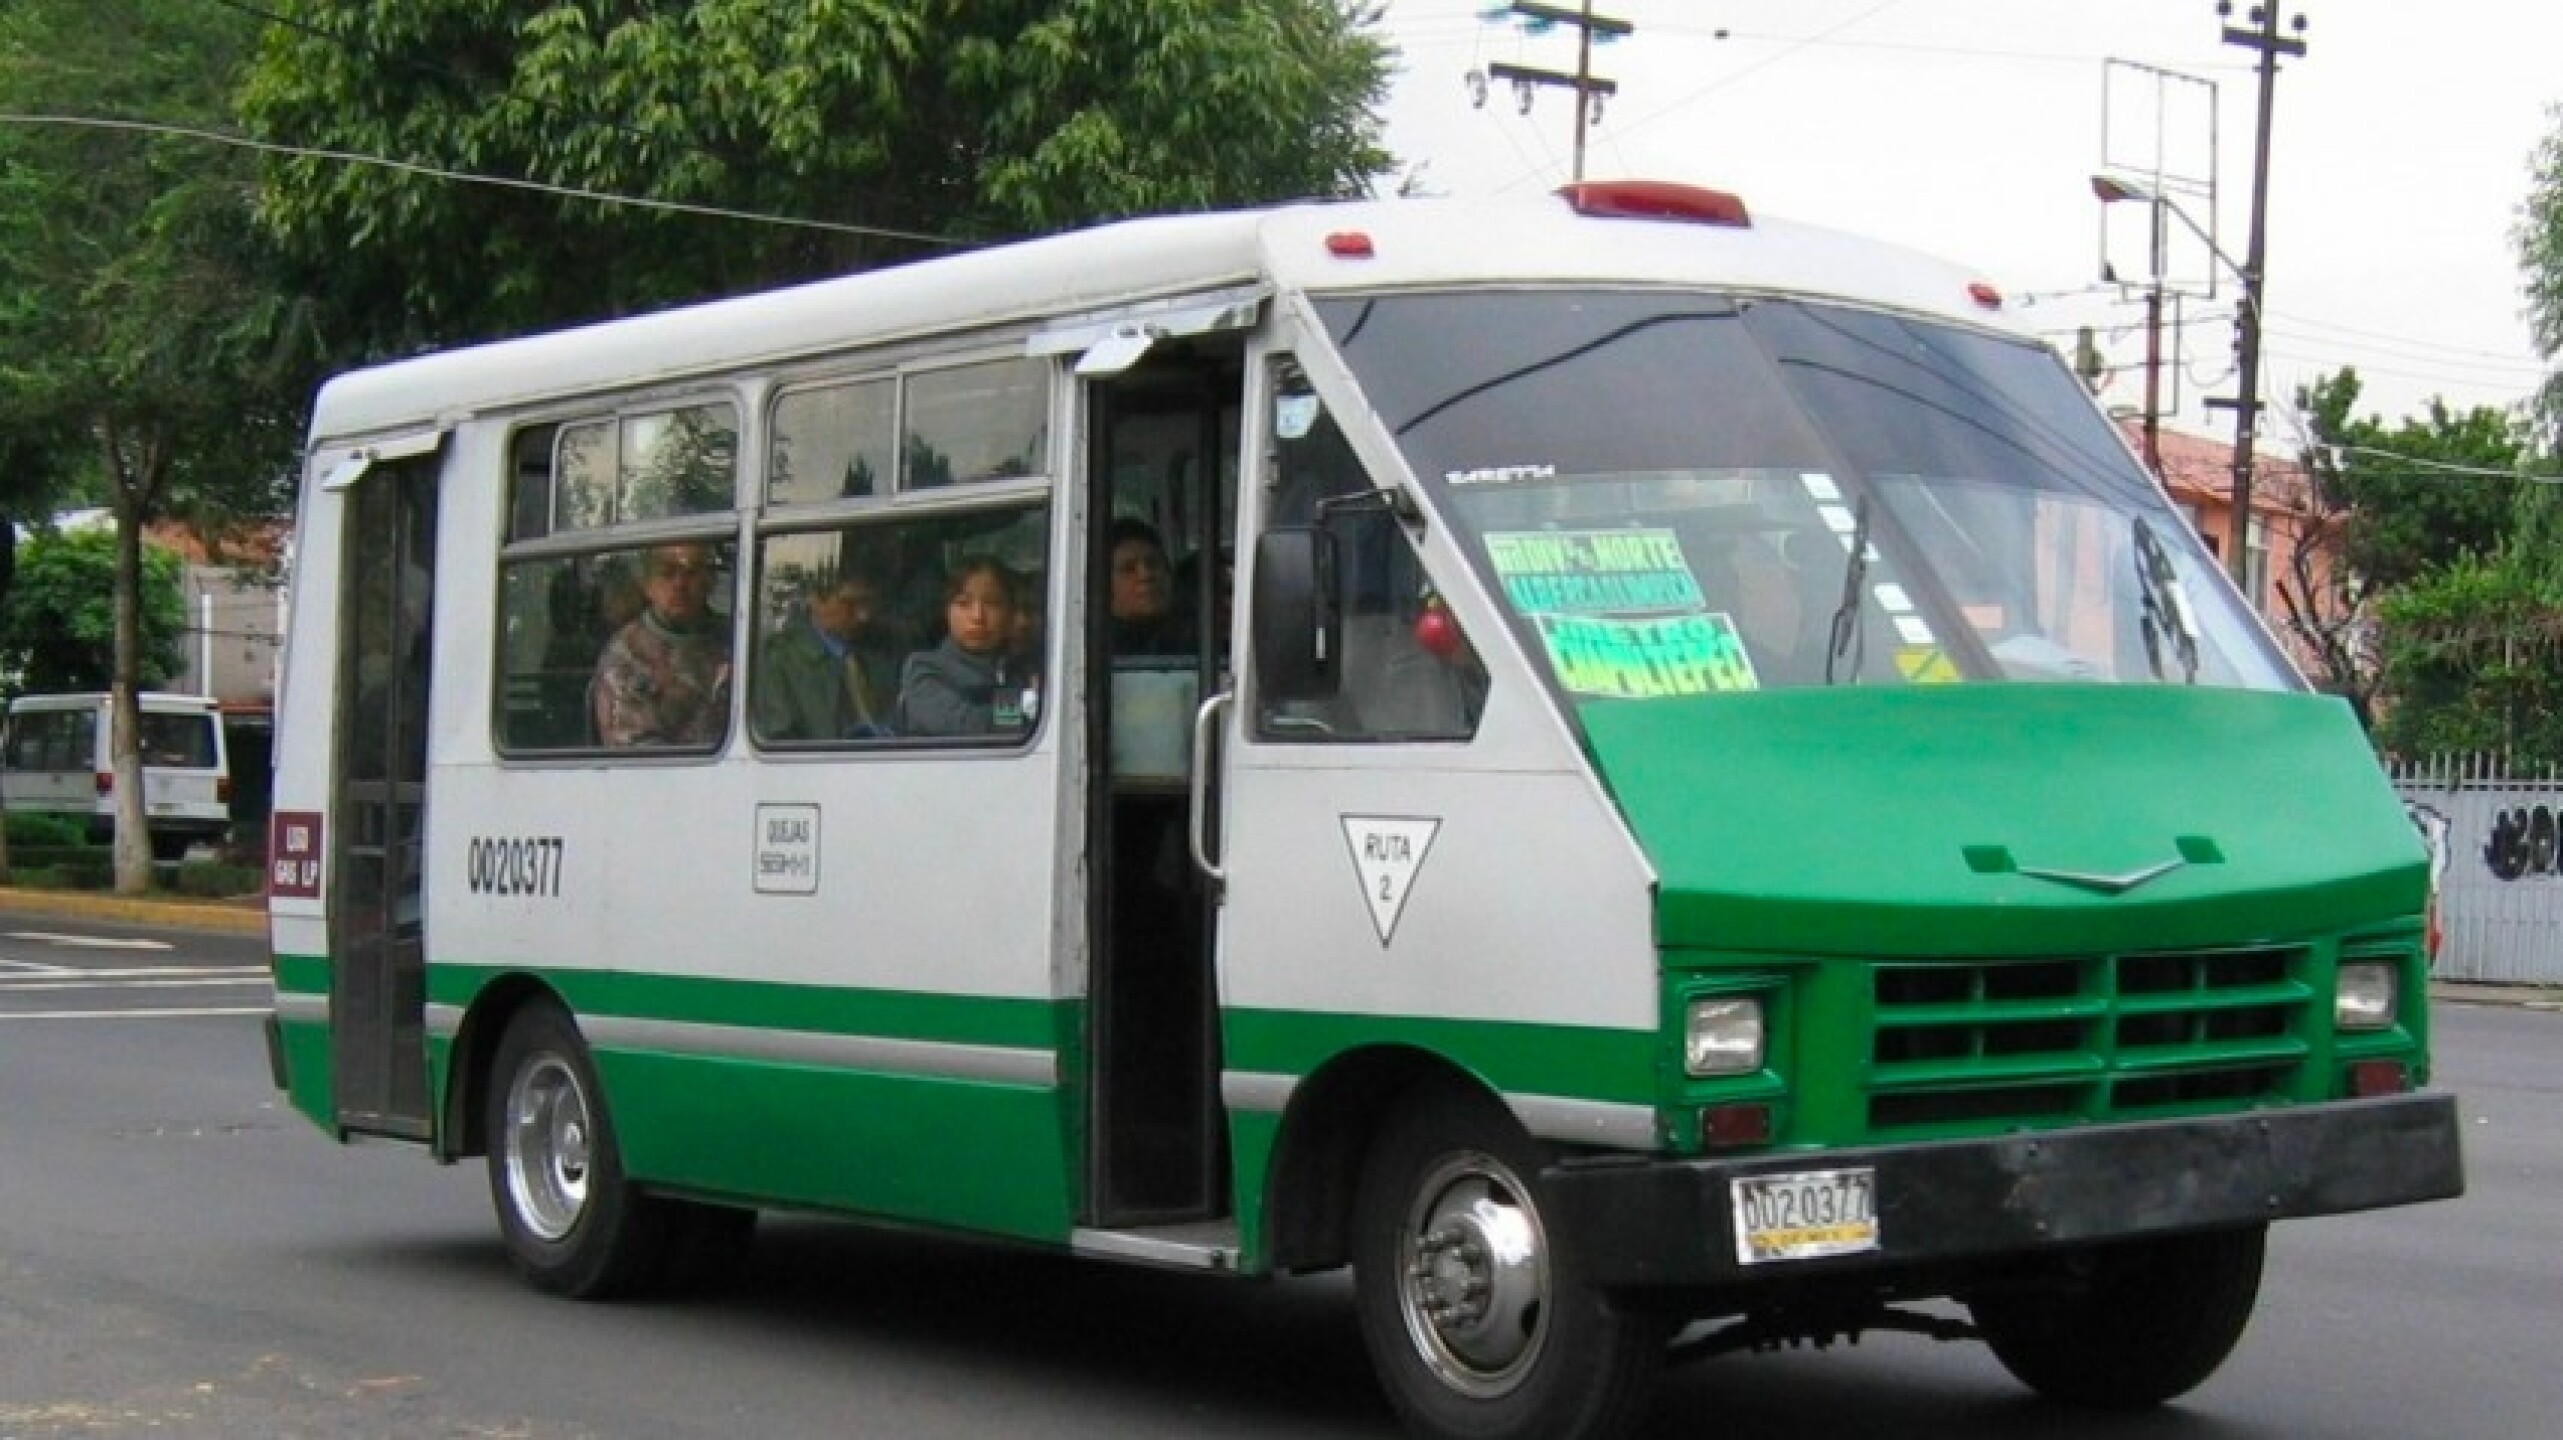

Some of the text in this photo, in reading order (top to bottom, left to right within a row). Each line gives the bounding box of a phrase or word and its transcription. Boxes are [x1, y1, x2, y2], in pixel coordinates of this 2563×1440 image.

[467, 836, 564, 897] 0020377
[1365, 833, 1410, 861] RUTA
[1379, 874, 1392, 902] 2
[1743, 1175, 1878, 1231] 0020377
